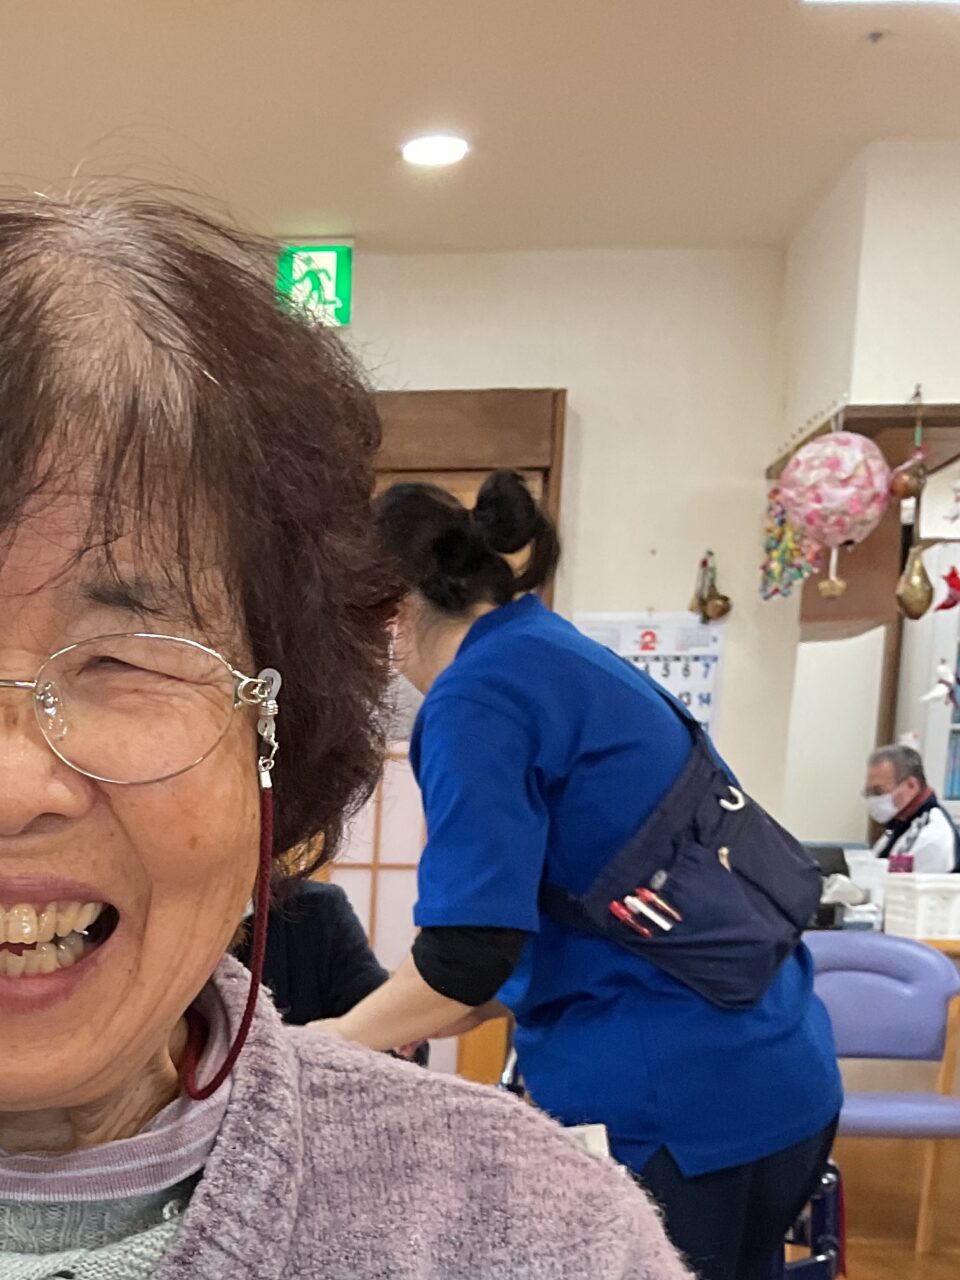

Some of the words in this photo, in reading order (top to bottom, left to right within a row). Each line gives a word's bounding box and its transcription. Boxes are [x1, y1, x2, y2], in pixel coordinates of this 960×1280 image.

[640, 630, 656, 651] 2
[661, 662, 670, 678] 5
[681, 662, 690, 678] 6
[702, 662, 711, 679] 7
[698, 691, 712, 706] 14
